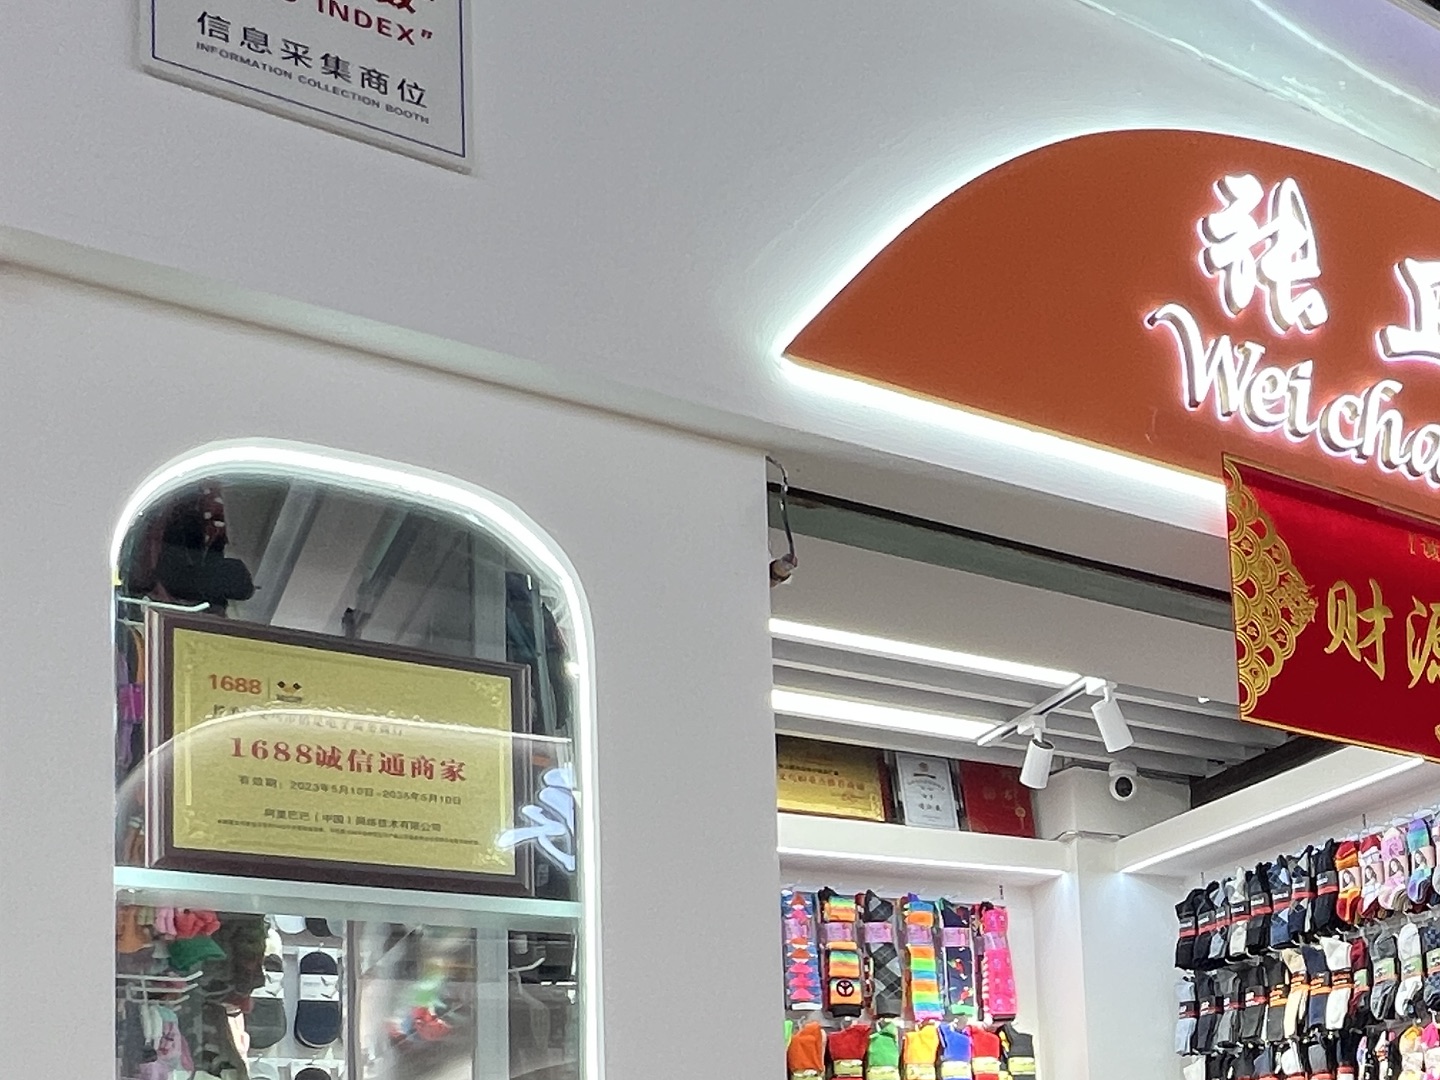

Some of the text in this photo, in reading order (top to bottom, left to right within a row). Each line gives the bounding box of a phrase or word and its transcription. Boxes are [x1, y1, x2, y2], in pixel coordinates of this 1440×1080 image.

[195, 40, 430, 125] INFORMATION COLLECTION BOOTH
[196, 10, 428, 109] 信息采集商位
[208, 674, 262, 695] 1688
[230, 736, 467, 783] 1688诚信通商家
